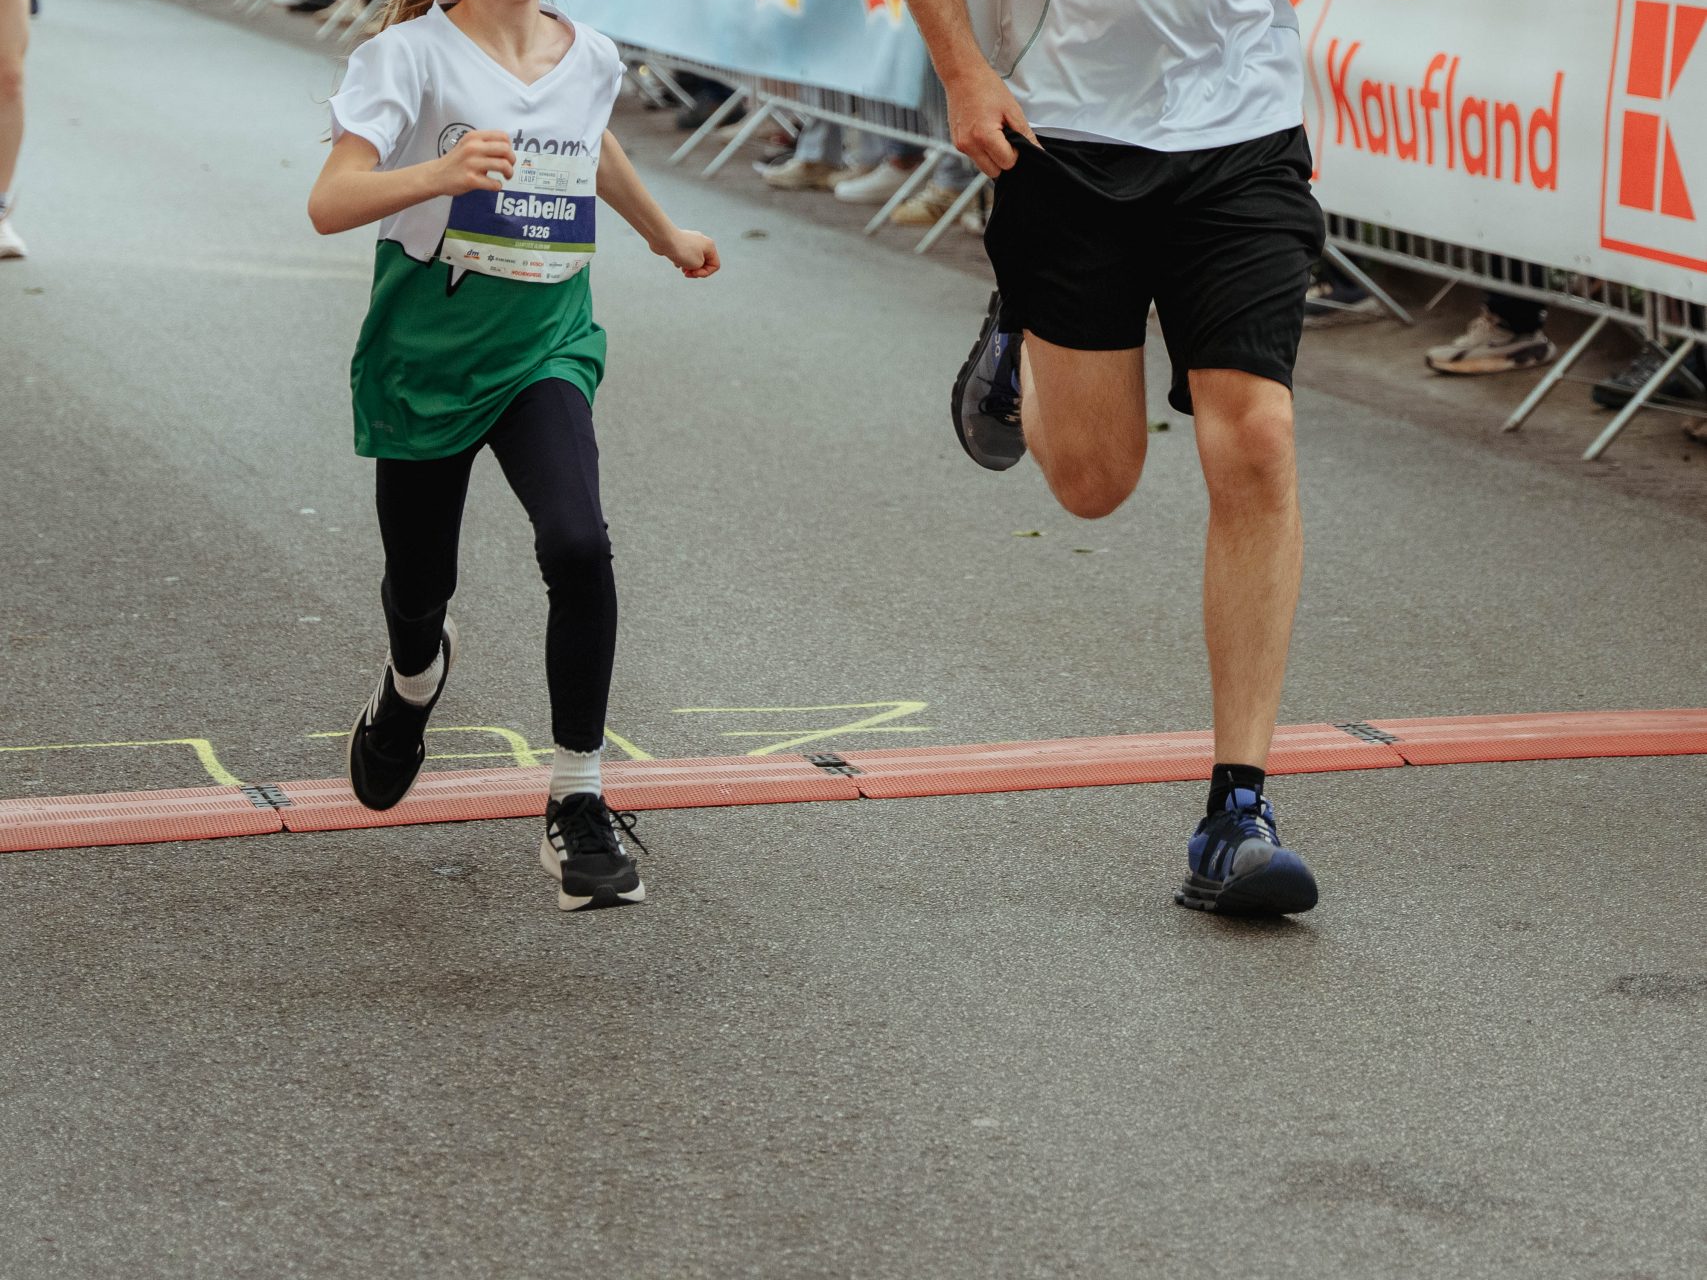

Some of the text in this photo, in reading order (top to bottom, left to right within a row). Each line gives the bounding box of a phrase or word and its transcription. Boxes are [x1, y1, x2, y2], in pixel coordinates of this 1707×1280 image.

[1326, 37, 1565, 192] Kaufland
[495, 191, 577, 221] Isabella
[521, 224, 550, 239] 1326
